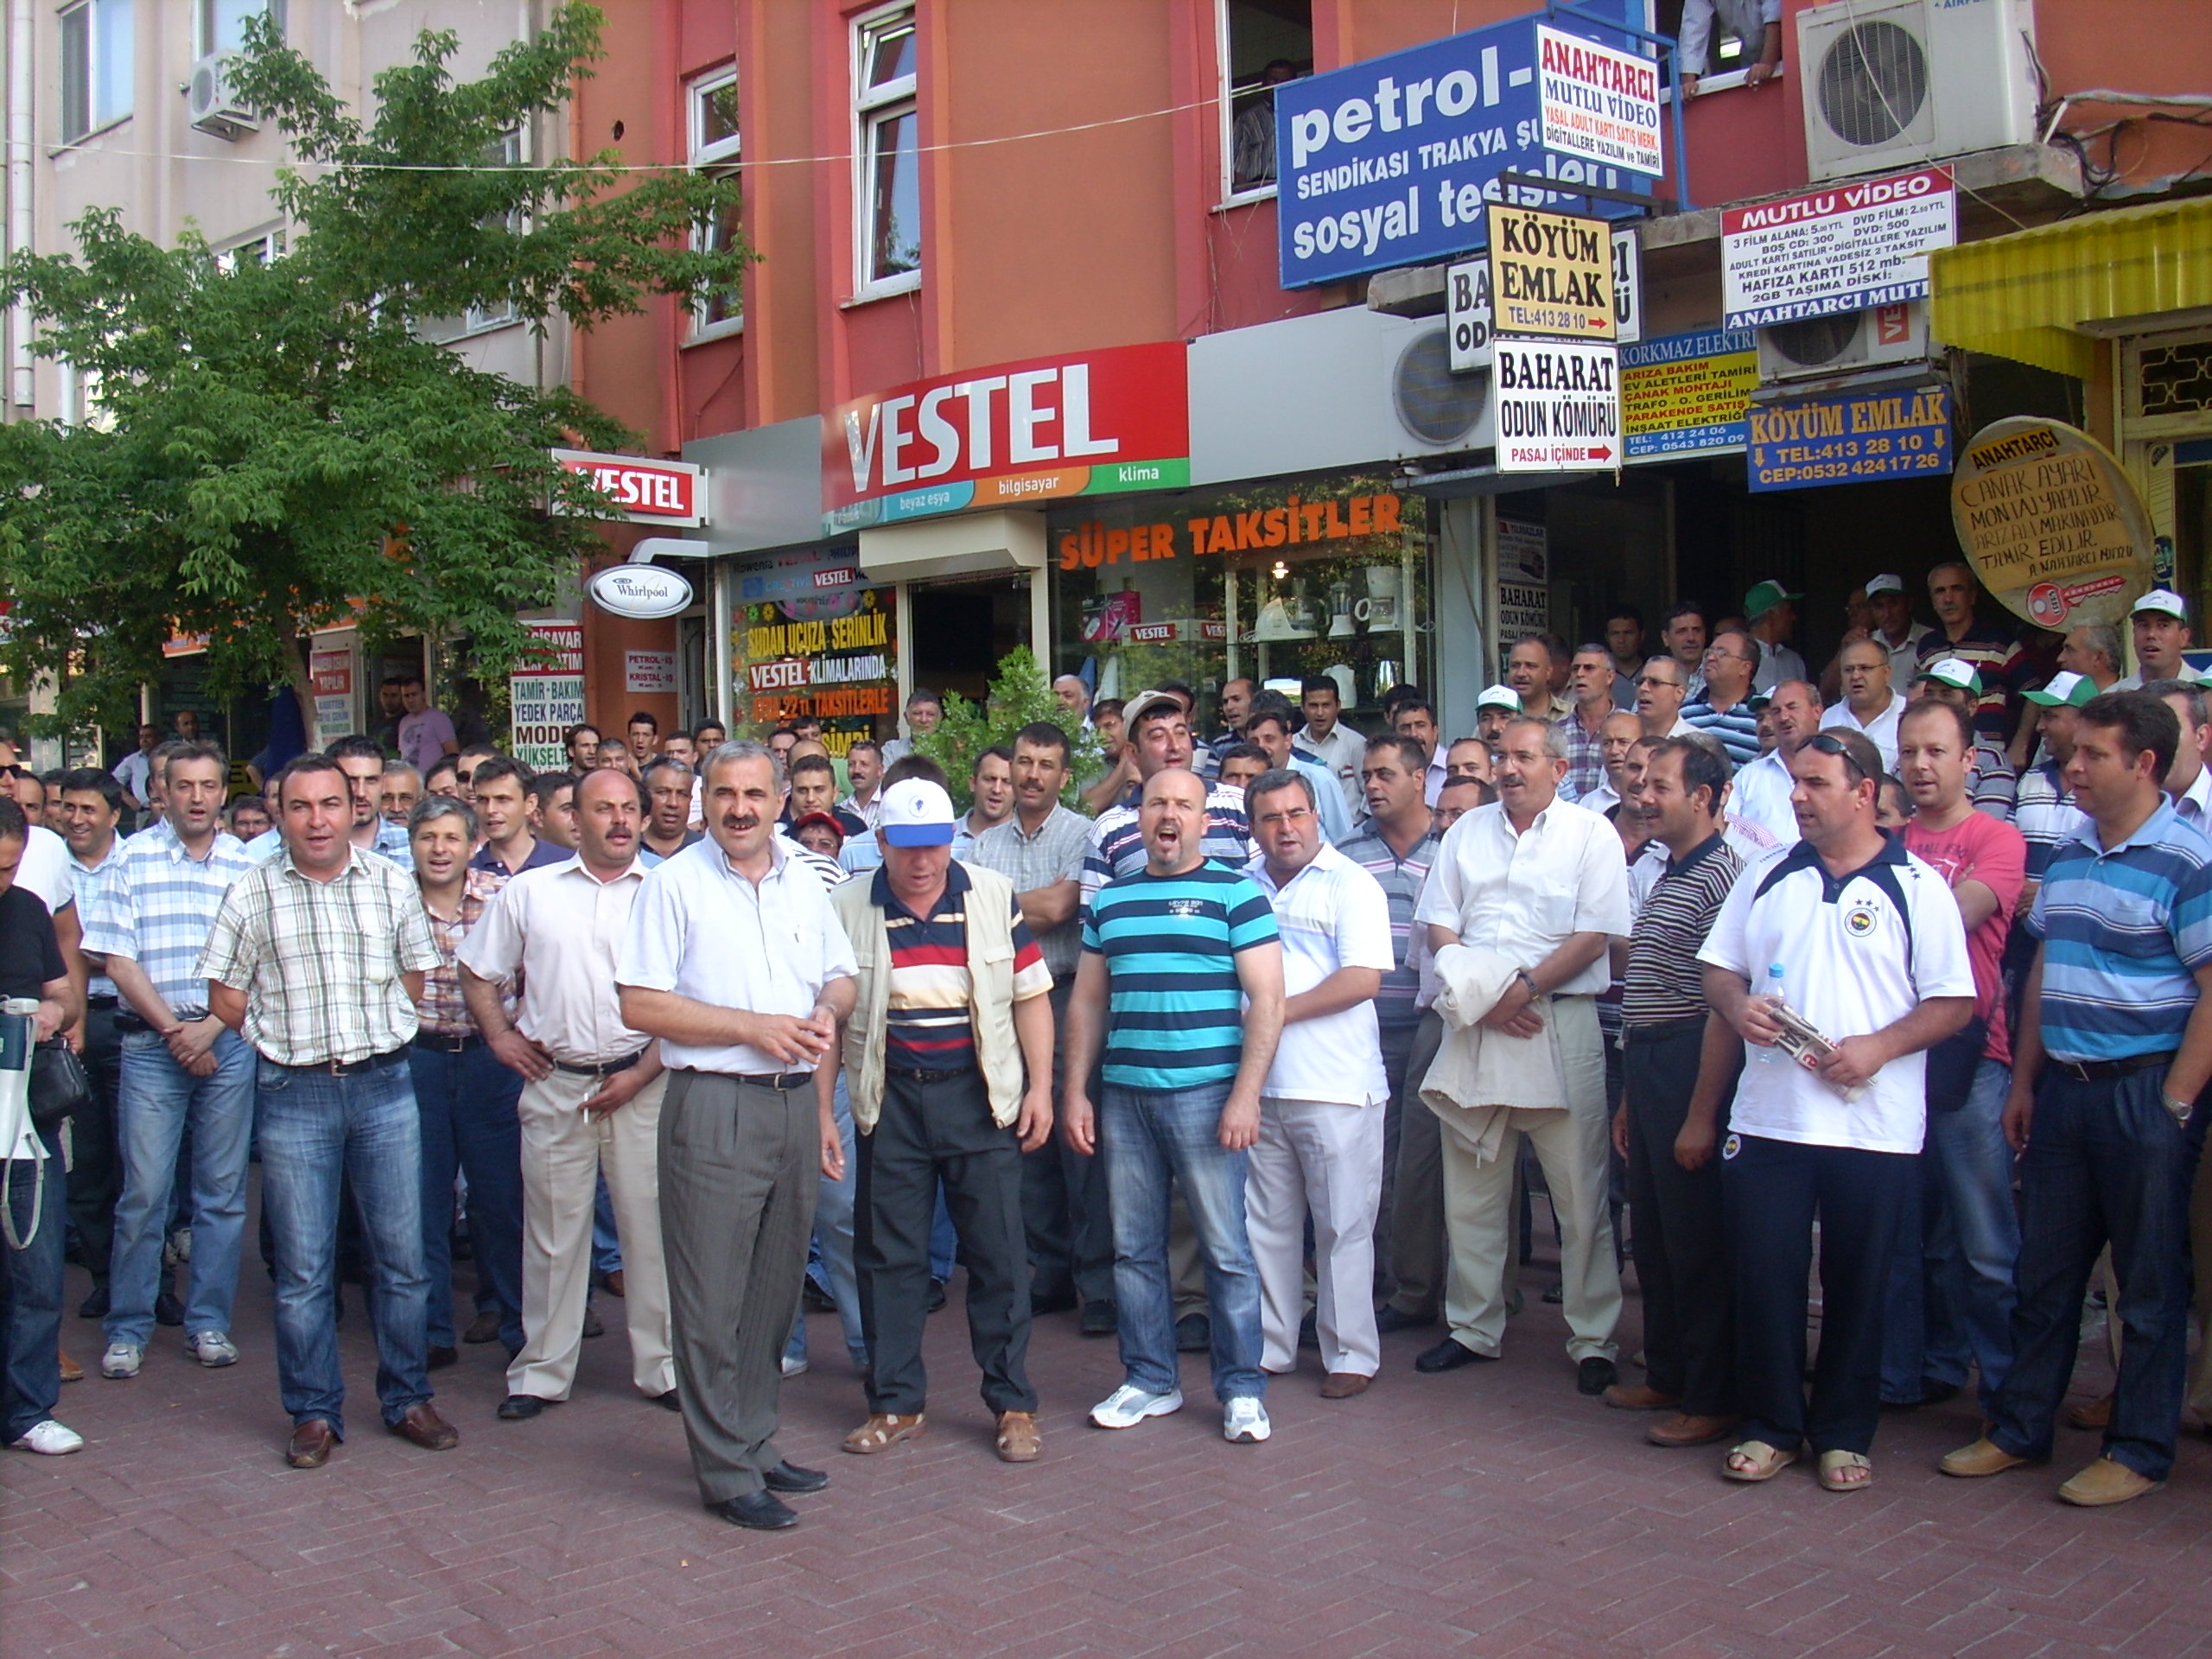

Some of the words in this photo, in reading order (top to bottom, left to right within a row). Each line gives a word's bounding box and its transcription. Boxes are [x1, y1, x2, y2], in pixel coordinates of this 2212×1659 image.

[1542, 38, 1655, 103] ANAHTARCI
[1291, 45, 1532, 168] petrol-
[1545, 77, 1603, 114] MUTLU
[1607, 94, 1656, 128] VİDEO
[1545, 105, 1568, 127] YASAL
[1571, 111, 1592, 132] ADULT
[1595, 118, 1615, 139] KARTI
[1617, 125, 1636, 147] SATIŞ
[1546, 124, 1594, 152] DİGİTALLERE
[1597, 141, 1624, 161] YAZILIM
[1626, 152, 1635, 163] ve
[1637, 149, 1660, 168] TAMİRİ
[1297, 149, 1409, 200] SENDİKASI
[1419, 127, 1507, 170] TRAKYA
[1742, 194, 1835, 229] MUTLU
[1844, 175, 1931, 208] VİDEO
[1294, 186, 1419, 259] sosyal
[1853, 213, 1875, 226] DVD
[1878, 207, 1909, 220] FİLM:
[1853, 225, 1883, 237] DVD:
[1886, 219, 1910, 230] 500
[1501, 213, 1599, 264] KÖYÜM
[1729, 258, 1759, 270] ADULT
[1762, 253, 1789, 265] KARTI
[1792, 245, 1827, 259] SATILIR
[1834, 231, 1900, 251] DİGİTALLERE
[1904, 223, 1947, 238] YAZILIM
[1733, 239, 1740, 249] 3
[1743, 234, 1768, 247] FİLM
[1770, 227, 1808, 242] ALANA:
[1762, 243, 1785, 255] BOŞ
[1789, 239, 1809, 249] CD:
[1813, 233, 1834, 245] 300
[1738, 266, 1770, 280] KREDİ
[1774, 259, 1821, 274] KARTINA
[1826, 248, 1871, 264] VADESİZ
[1885, 238, 1925, 253] TAKSİT
[1499, 261, 1605, 308] EMLAK
[1742, 275, 1795, 294] HAFIZA
[1800, 265, 1845, 283] KARTI
[1849, 259, 1875, 275] 512
[1751, 291, 1781, 303] 2GB
[1786, 281, 1841, 296] TAŞIMA
[1847, 269, 1892, 287] DİSKİ:
[1558, 308, 1570, 327] 28
[1573, 312, 1586, 329] 10
[1728, 294, 1861, 330] ANAHTARCI
[1620, 339, 1693, 367] KORKMAZ
[1499, 352, 1613, 391] BAHARAT
[1624, 368, 1662, 381] ARIZA
[1667, 361, 1709, 378] BAKIM
[1624, 382, 1640, 391] EV
[1644, 371, 1707, 389] ALETLERİ
[1711, 364, 1757, 380] TAMİRİ
[1624, 386, 1669, 403] ÇANAK
[1674, 379, 1732, 395] MONTAJI
[1624, 398, 1667, 412] TRAFO
[1696, 388, 1750, 404] GERİLİM
[1502, 399, 1548, 438] ODUN
[1553, 395, 1617, 438] KÖMÜRÜ
[1624, 405, 1703, 423] PARAKENDE
[1707, 400, 1745, 413] SATIŞ
[1749, 402, 1844, 445] KÖYÜM
[1850, 393, 1948, 434] EMLAK
[843, 363, 1120, 493] VESTEL
[1625, 420, 1672, 435] İNŞAAT
[1629, 435, 1652, 444] TEL:
[1660, 432, 1684, 441] 412
[1689, 429, 1705, 437] 24
[1709, 427, 1726, 435] 06
[1512, 448, 1547, 461] PASAJ
[1551, 443, 1586, 465] İÇİNDE
[1629, 445, 1658, 455] CEP:
[1662, 439, 1694, 451] 0543
[1699, 436, 1724, 446] 820
[1727, 434, 1745, 443] 09
[1866, 437, 1891, 454] 28
[1897, 434, 1923, 450] 10
[1971, 429, 2061, 470] ANAHTARCI
[1118, 465, 1160, 484] klima
[1851, 458, 1887, 474] 424
[1890, 454, 1913, 471] 17
[1916, 453, 1939, 469] 26
[2037, 458, 2097, 489] AYARI
[997, 476, 1059, 497] bilgisayar
[899, 493, 926, 511] beyaz
[927, 490, 950, 507] eşya
[1059, 522, 1176, 570] SÜPER
[1188, 494, 1402, 555] TAKSİTLER
[617, 584, 669, 599] Whirlpool
[814, 569, 851, 587] VESTEL
[1500, 587, 1547, 609] BAHARAT
[1500, 610, 1519, 626] ODUN
[747, 624, 785, 658] SUDAN
[830, 607, 887, 650] SERİNLİK
[1135, 626, 1170, 639] VESTEL
[751, 663, 807, 689] VESTEL
[810, 654, 887, 684] KLİMALARINDA
[514, 678, 544, 700] TAMİR
[551, 681, 583, 701] BAKIM
[514, 703, 546, 722] YEDEK
[550, 703, 583, 724] PARÇA
